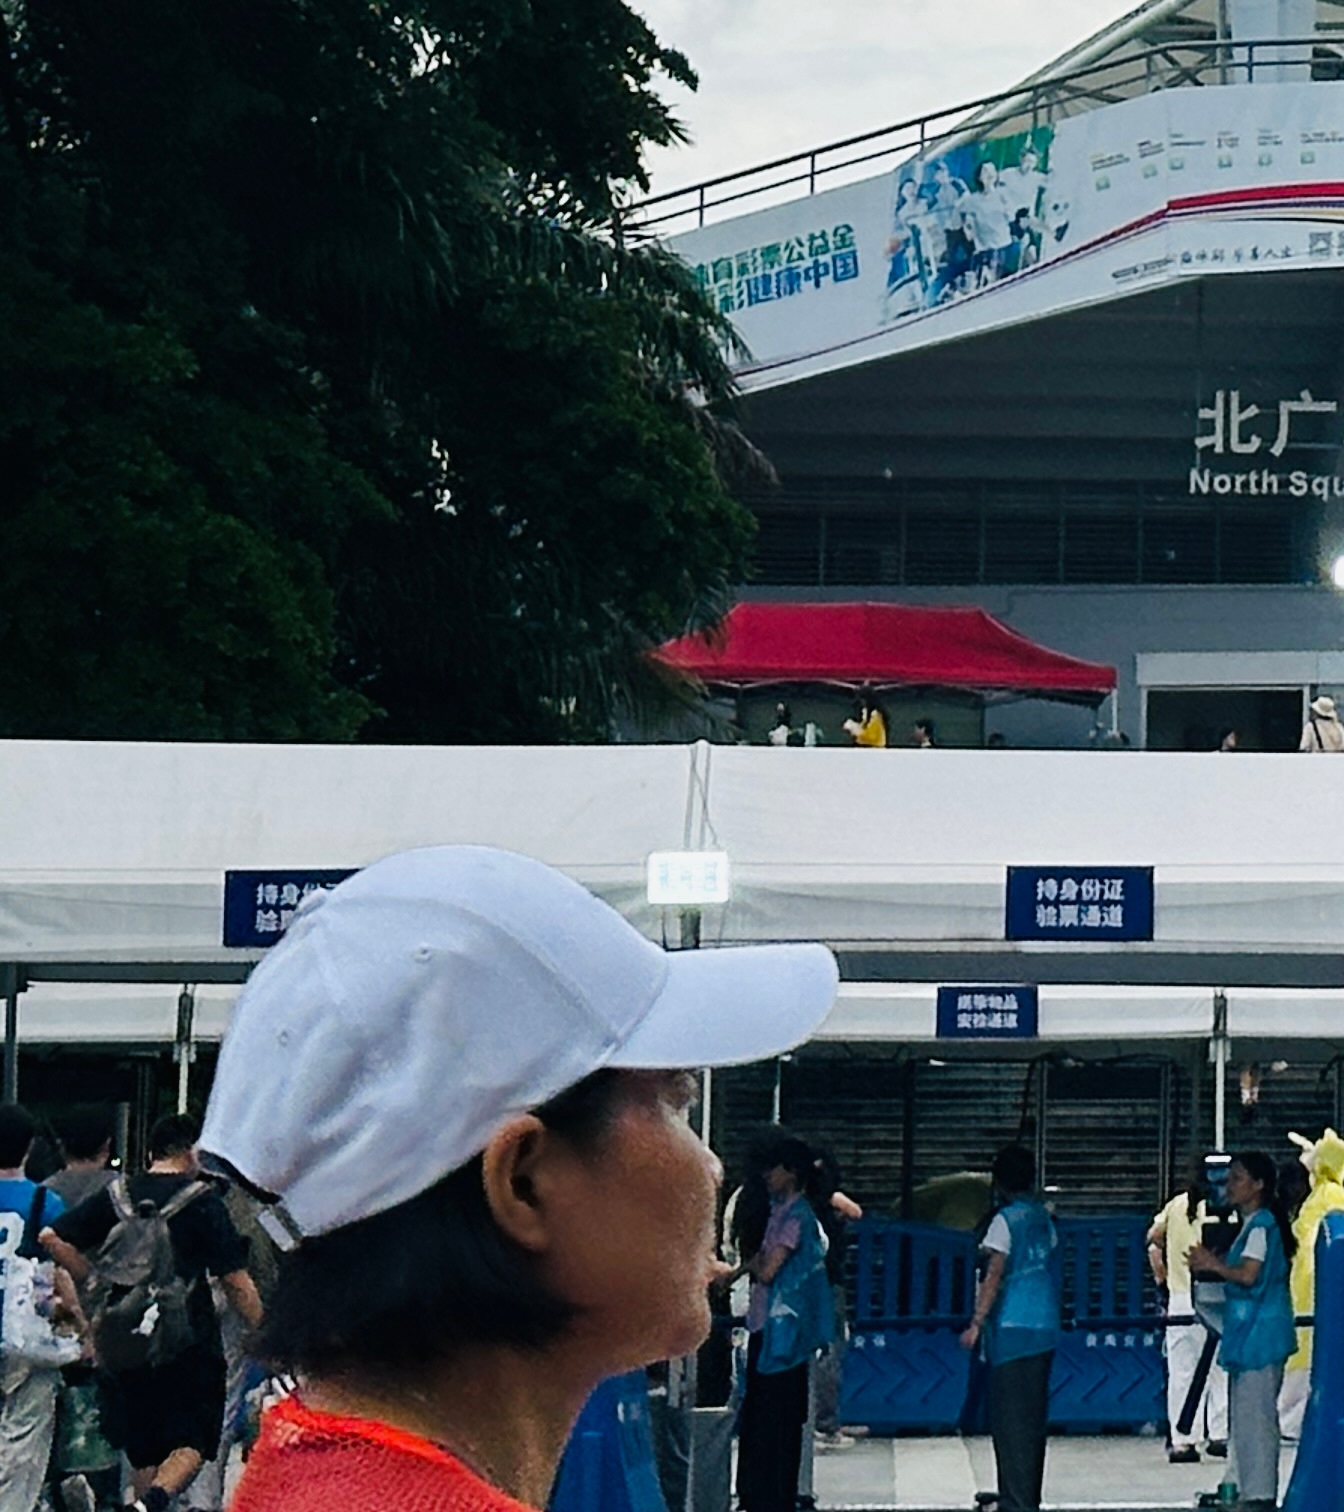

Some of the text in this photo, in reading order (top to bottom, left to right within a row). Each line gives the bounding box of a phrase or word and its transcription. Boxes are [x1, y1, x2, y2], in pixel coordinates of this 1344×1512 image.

[708, 249, 859, 314] 彩健康中国
[1189, 467, 1278, 495] North
[1036, 877, 1124, 901] 持身份证
